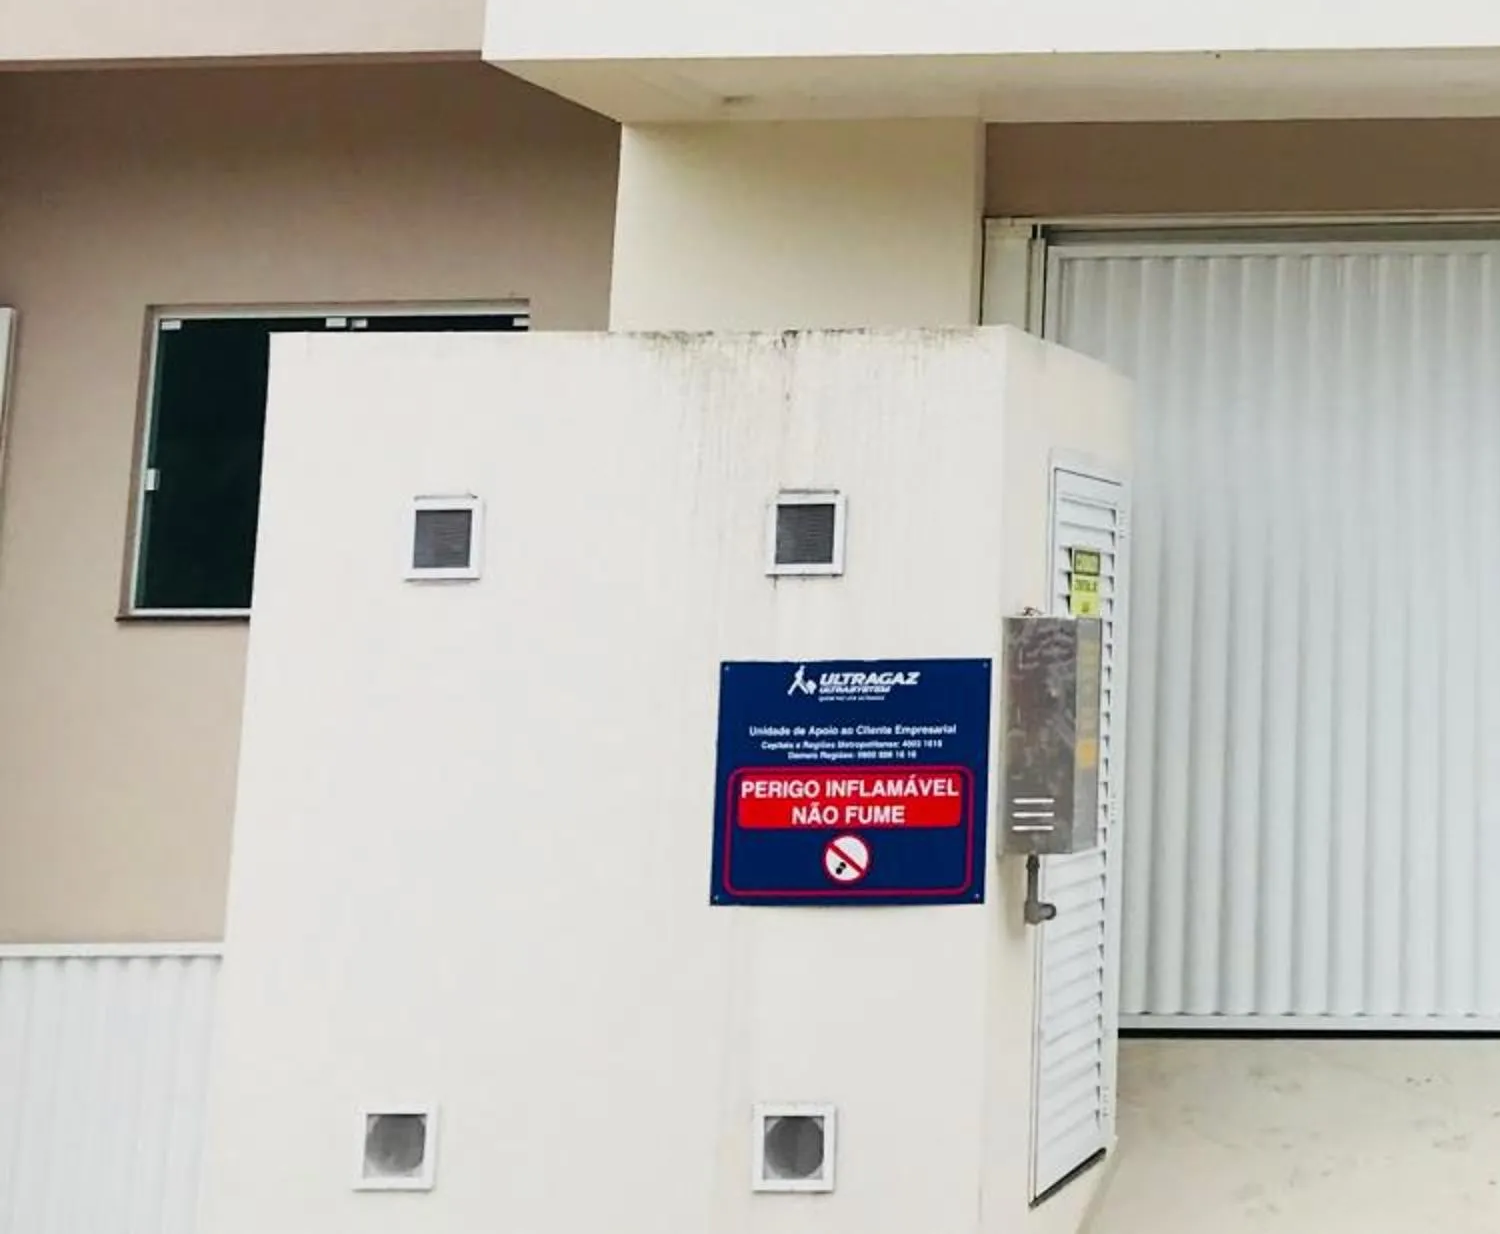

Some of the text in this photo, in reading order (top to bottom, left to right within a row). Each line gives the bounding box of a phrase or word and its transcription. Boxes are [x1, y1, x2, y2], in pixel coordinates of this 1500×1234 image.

[820, 671, 920, 686] ULTRAGAZ
[749, 725, 791, 737] Unidade
[793, 726, 806, 736] de
[808, 725, 839, 738] Apoio
[895, 723, 957, 737] Empresarial
[741, 774, 960, 799] PERIGO INFLAMÁVEL
[792, 801, 906, 825] NÃO FUME
